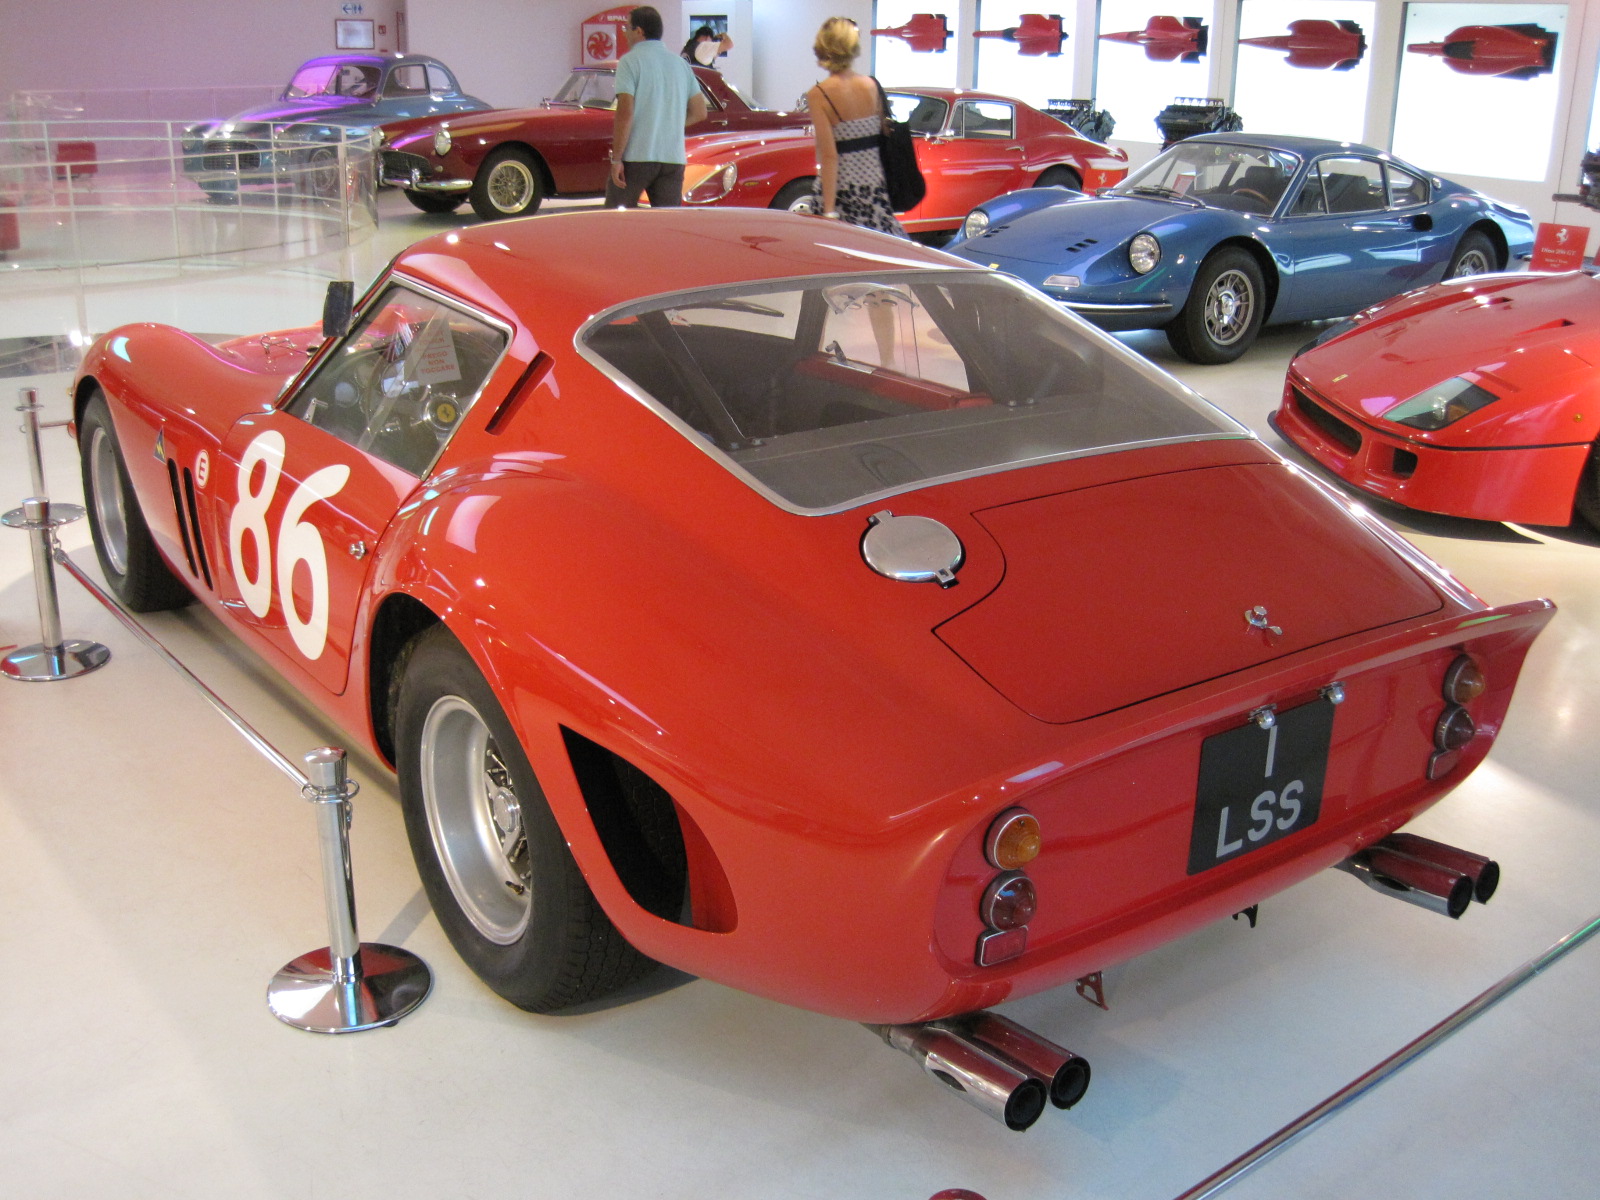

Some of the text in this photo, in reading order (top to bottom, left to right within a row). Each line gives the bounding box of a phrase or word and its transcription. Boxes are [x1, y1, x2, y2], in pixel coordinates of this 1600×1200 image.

[198, 457, 207, 481] E
[229, 430, 350, 660] 86
[1216, 779, 1304, 858] LSS
